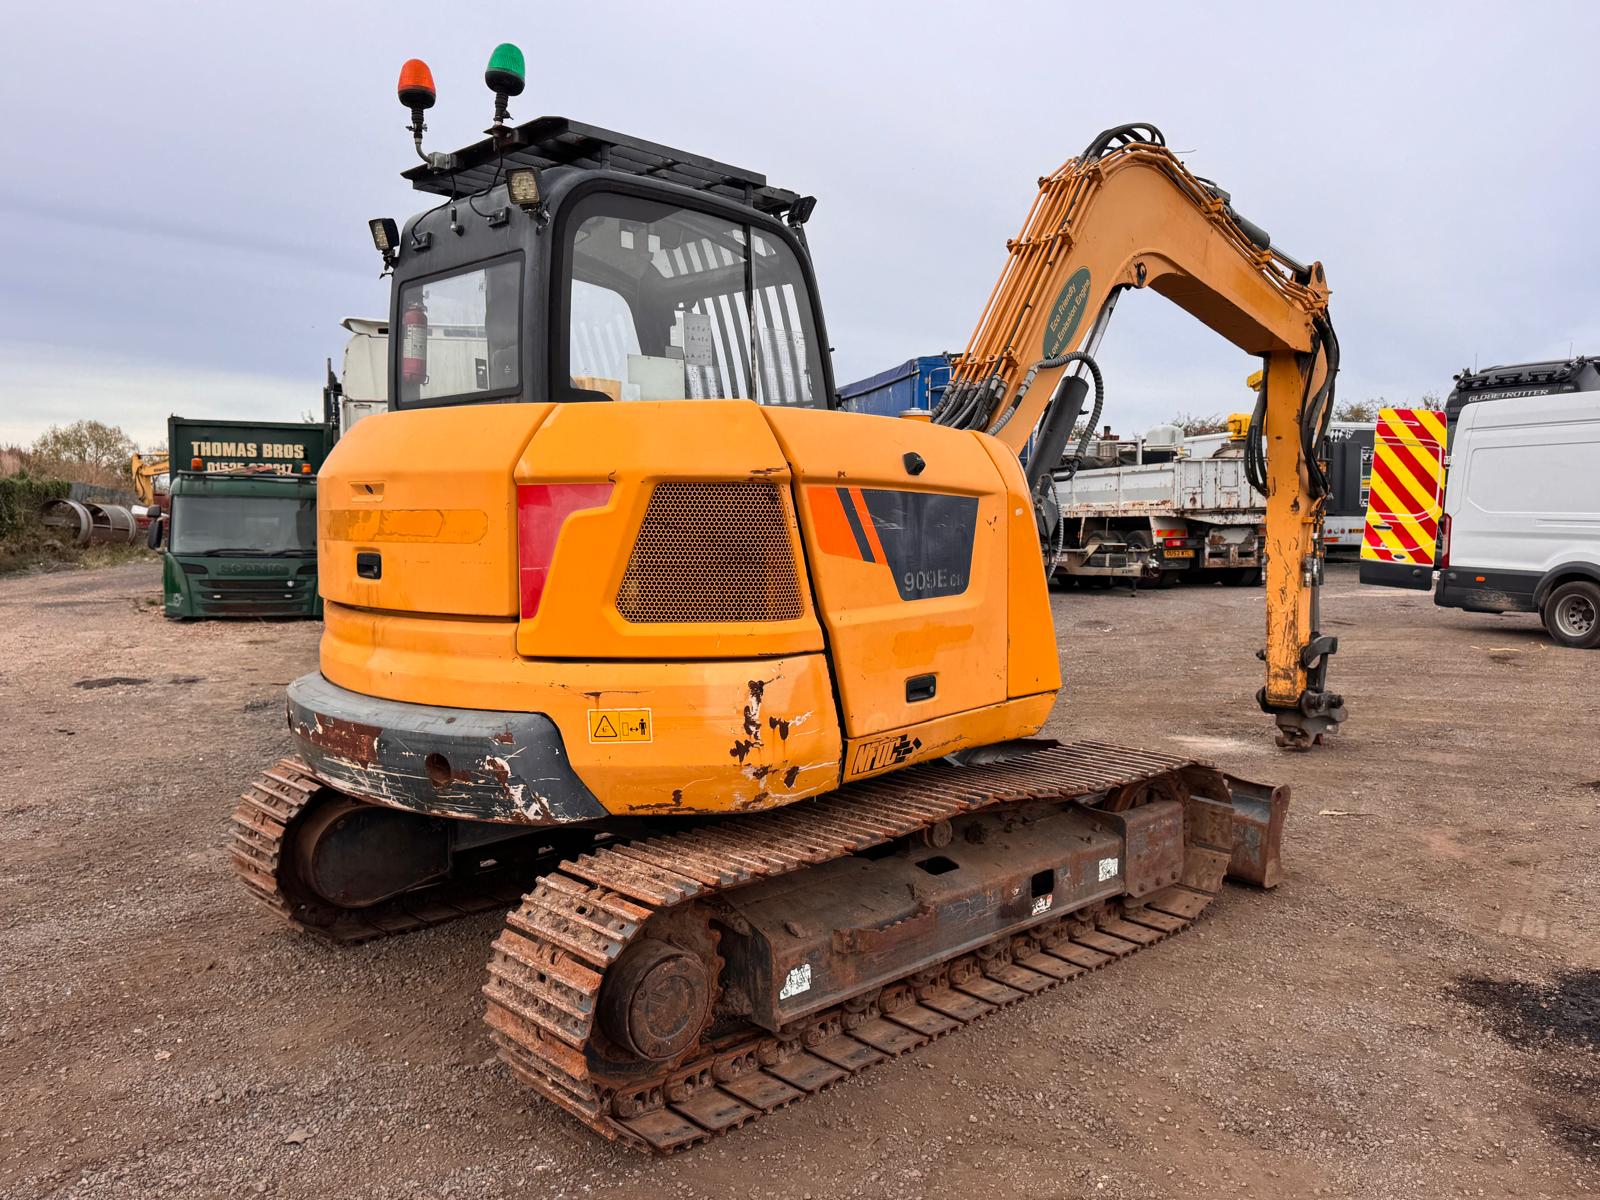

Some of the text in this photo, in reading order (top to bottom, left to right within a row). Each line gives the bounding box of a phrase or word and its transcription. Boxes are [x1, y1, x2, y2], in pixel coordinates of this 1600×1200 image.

[1049, 340, 1060, 359] Low
[1058, 305, 1078, 341] Emission
[1050, 314, 1060, 332] Eco
[1468, 389, 1549, 402] GLOBETROTTER
[191, 441, 304, 459] THOMAS BROS
